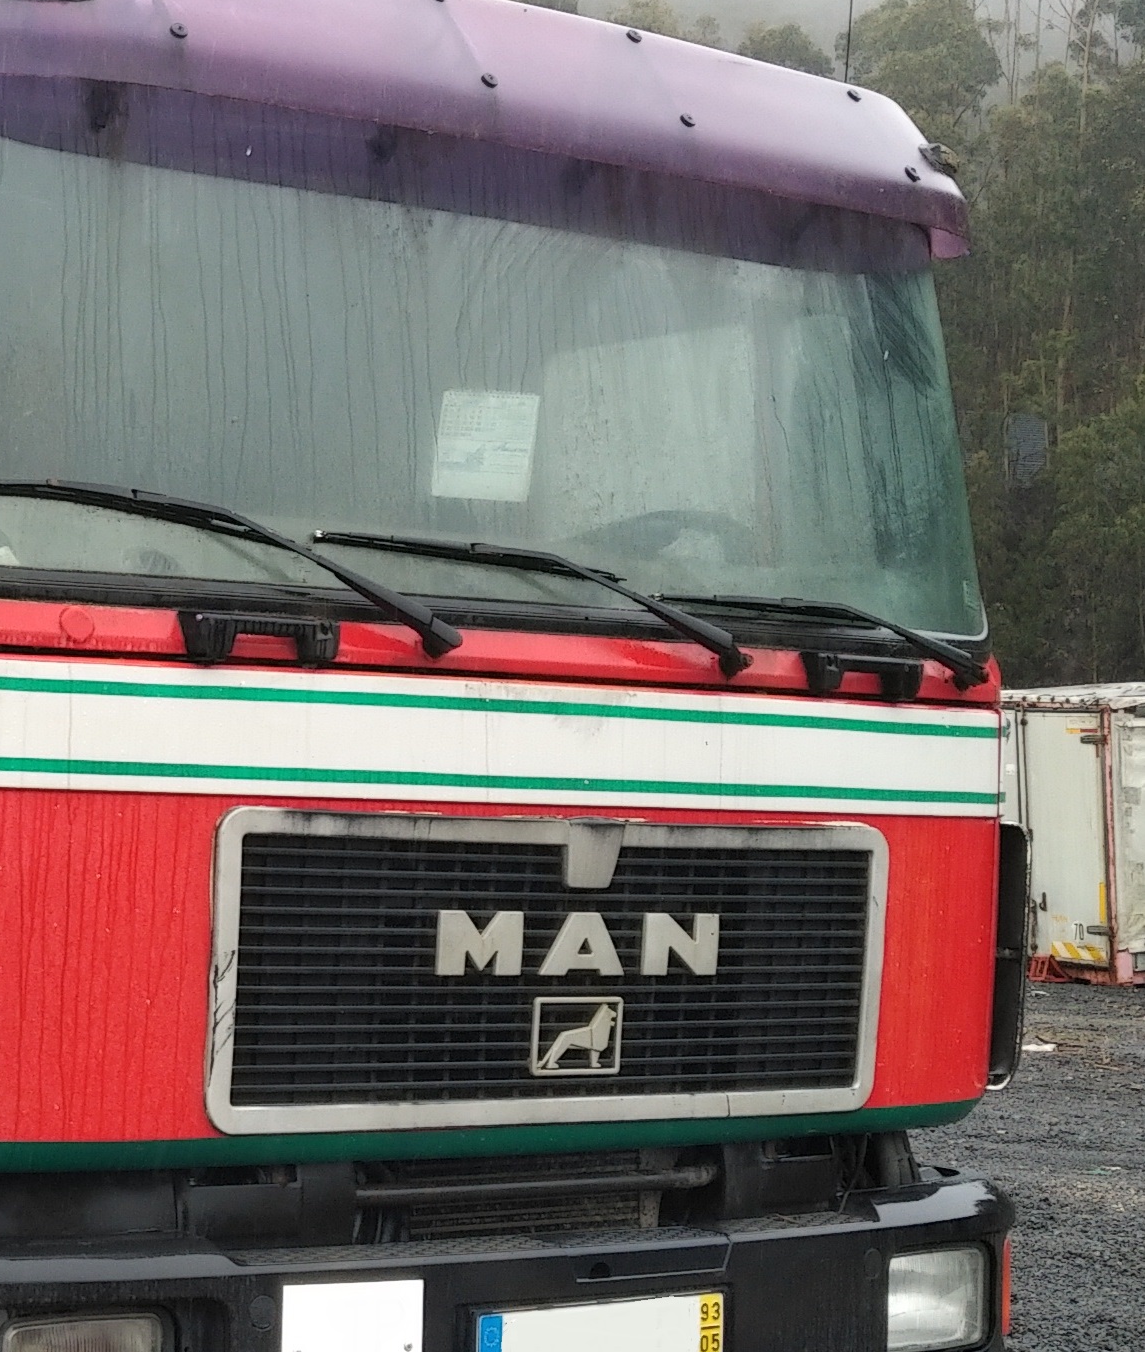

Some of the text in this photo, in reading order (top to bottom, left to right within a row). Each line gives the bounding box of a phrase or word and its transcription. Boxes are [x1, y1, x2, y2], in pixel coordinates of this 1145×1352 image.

[1073, 923, 1085, 941] 70
[434, 909, 720, 977] MAN
[700, 1301, 721, 1322] 93
[699, 1332, 721, 1352] 05
